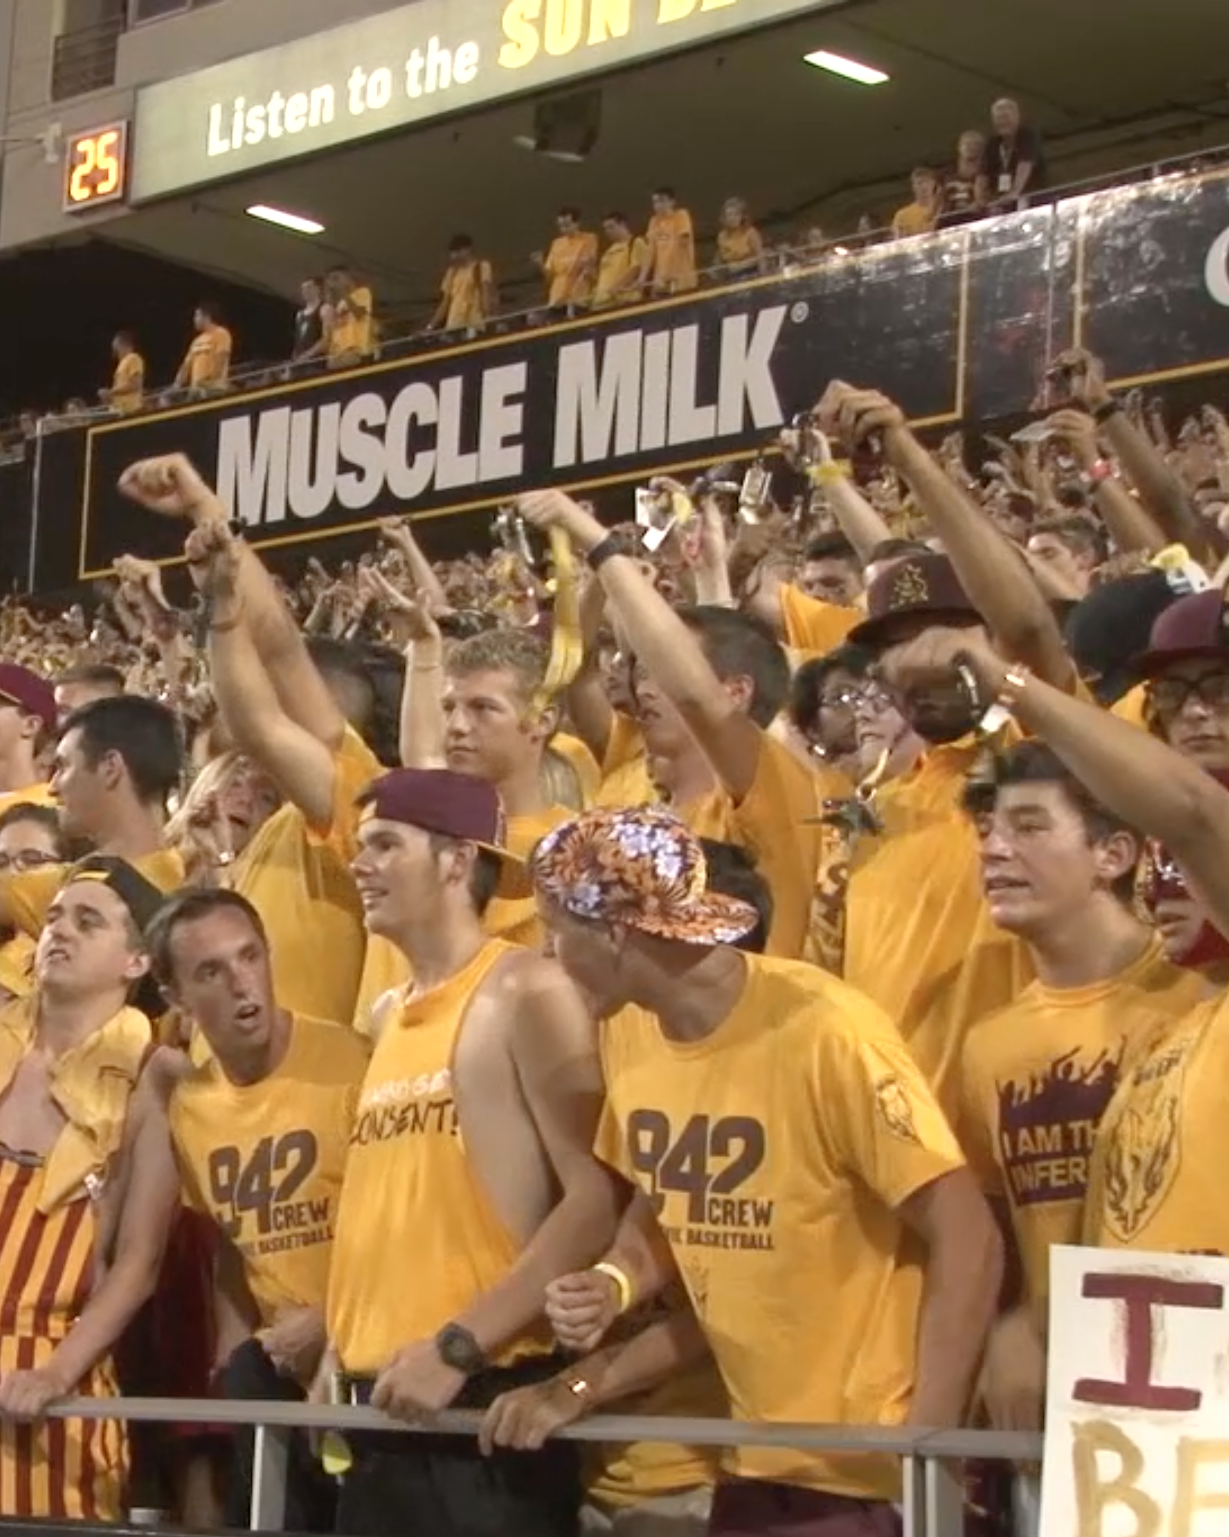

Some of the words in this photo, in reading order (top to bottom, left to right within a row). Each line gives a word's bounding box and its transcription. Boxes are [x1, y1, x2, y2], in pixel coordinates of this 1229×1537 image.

[498, 0, 631, 68] SUN
[207, 83, 335, 156] Listen
[348, 66, 392, 115] to
[406, 36, 479, 98] the
[70, 131, 119, 201] 25
[216, 362, 528, 527] MUSCLE
[553, 304, 788, 469] MILK
[350, 1098, 458, 1146] ONSENT!
[1018, 1124, 1063, 1156] AM
[628, 1108, 765, 1224] 942
[1010, 1156, 1087, 1193] INFER
[272, 1196, 330, 1232] CREW
[708, 1197, 773, 1227] CREW
[258, 1225, 334, 1255] BASKETBALL
[687, 1227, 775, 1251] BASKETBALL
[1071, 1271, 1224, 1412] I
